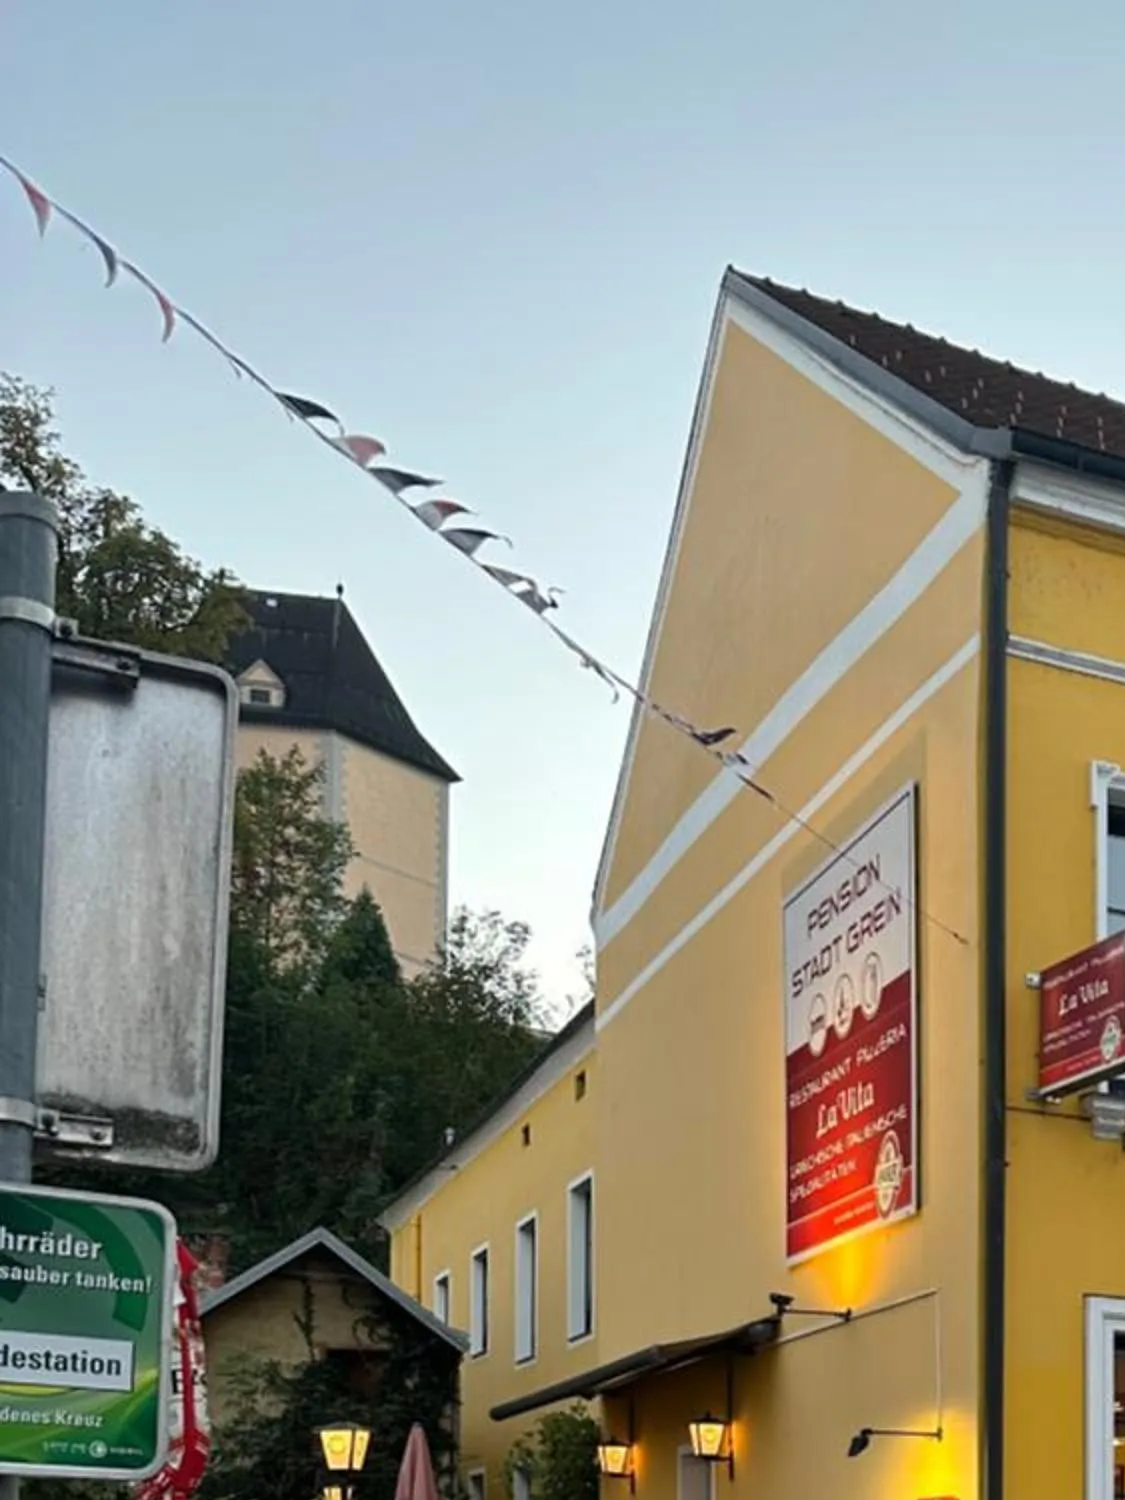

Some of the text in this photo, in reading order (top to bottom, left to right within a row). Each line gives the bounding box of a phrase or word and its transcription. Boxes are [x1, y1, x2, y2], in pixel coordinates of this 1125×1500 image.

[807, 853, 881, 939] PENSION
[792, 887, 902, 998] STADT GREIN
[815, 1080, 875, 1140] La Vita
[0, 1225, 103, 1260] hrräder
[0, 1264, 152, 1294] sauber tanken!
[0, 1343, 122, 1377] destation
[0, 1405, 104, 1428] denes Kreuz
